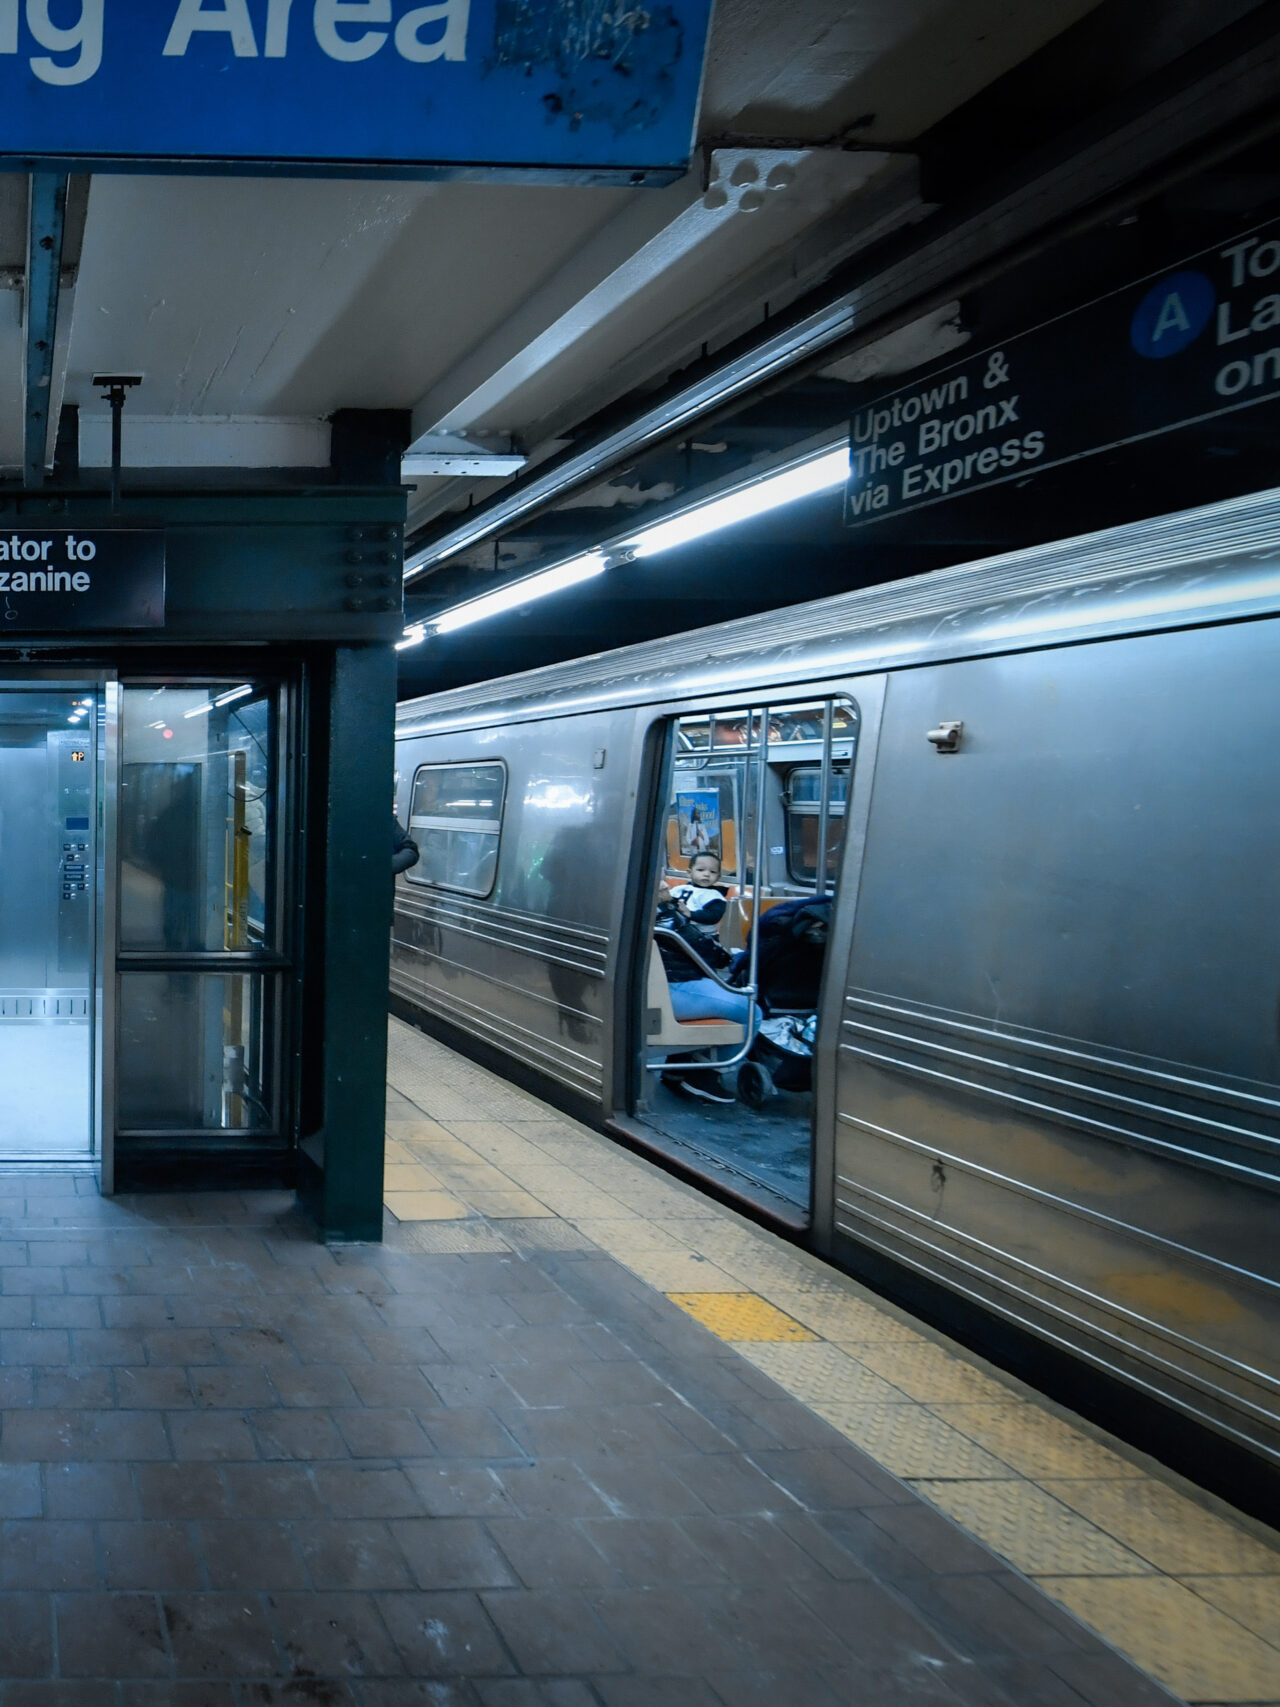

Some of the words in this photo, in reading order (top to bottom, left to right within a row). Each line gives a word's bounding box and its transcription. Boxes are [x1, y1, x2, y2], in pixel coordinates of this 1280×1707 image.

[1221, 237, 1280, 288] To
[1152, 292, 1191, 343] A
[853, 375, 969, 443] Uptown
[982, 351, 1011, 389] &
[853, 441, 906, 478] The
[918, 395, 1020, 456] Bronx
[851, 482, 890, 516] via
[901, 430, 1046, 500] Express
[65, 534, 97, 562] to
